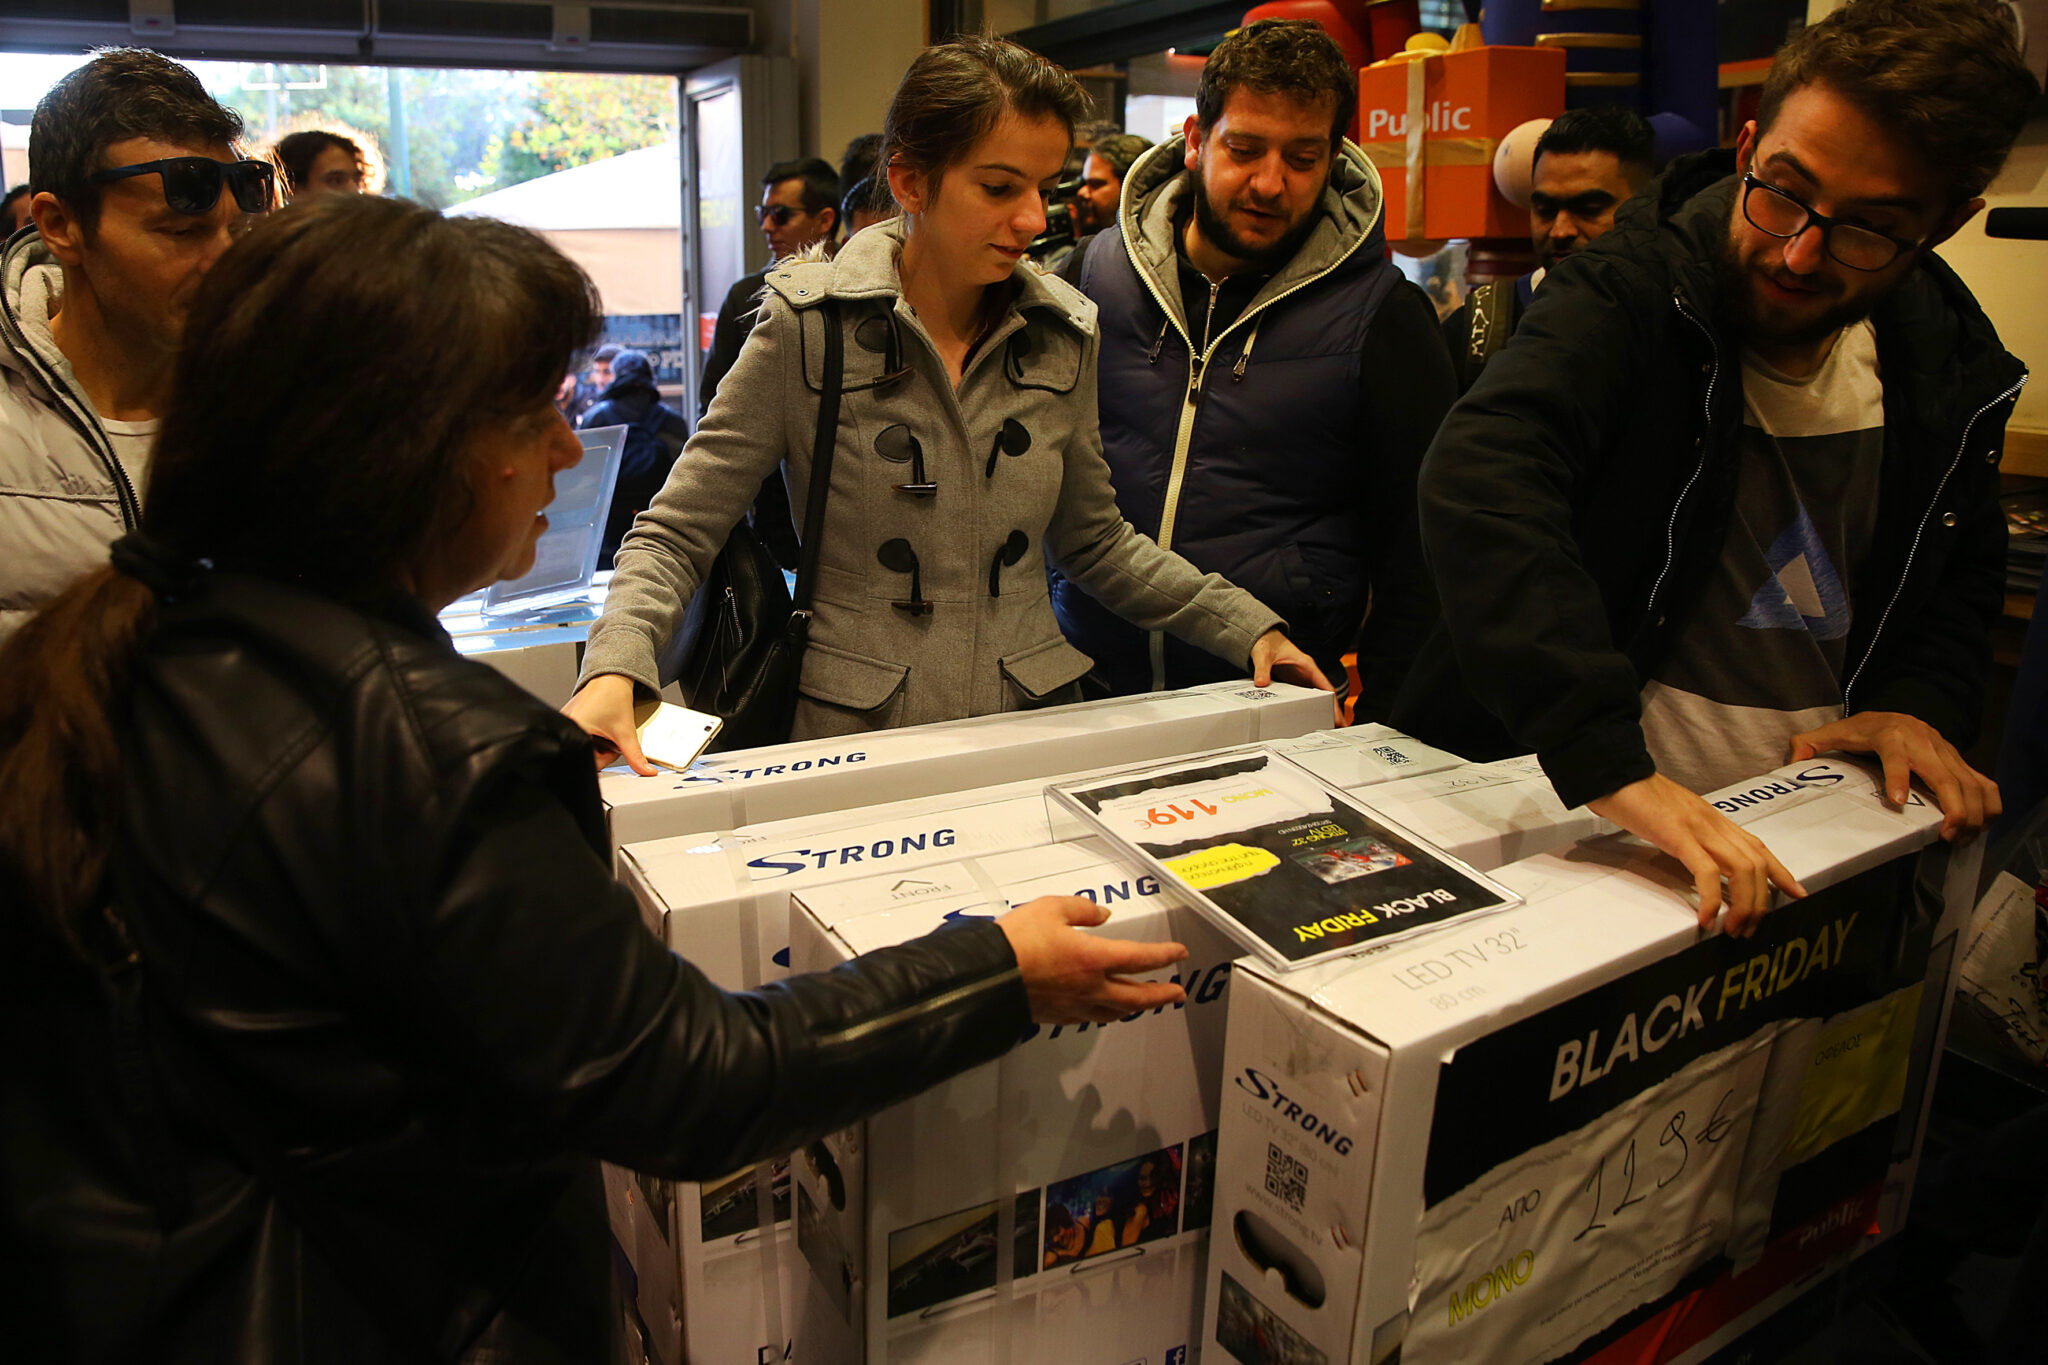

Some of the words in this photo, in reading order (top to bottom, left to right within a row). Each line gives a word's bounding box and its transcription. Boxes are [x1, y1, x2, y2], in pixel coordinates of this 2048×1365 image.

[1369, 100, 1471, 138] Pulic
[673, 752, 866, 790] STRONG
[746, 828, 955, 882] STRONG
[1373, 888, 1457, 919] BLACK
[1293, 909, 1380, 943] FRIDAY
[1392, 960, 1453, 991] LED
[1444, 943, 1488, 968] TV
[1485, 927, 1528, 954] 32"
[1429, 992, 1459, 1011] 80
[1458, 986, 1487, 1000] cm
[1549, 975, 1716, 1102] BLACK
[1716, 911, 1859, 1021] FRIDAY
[1235, 1067, 1354, 1156] STRONG
